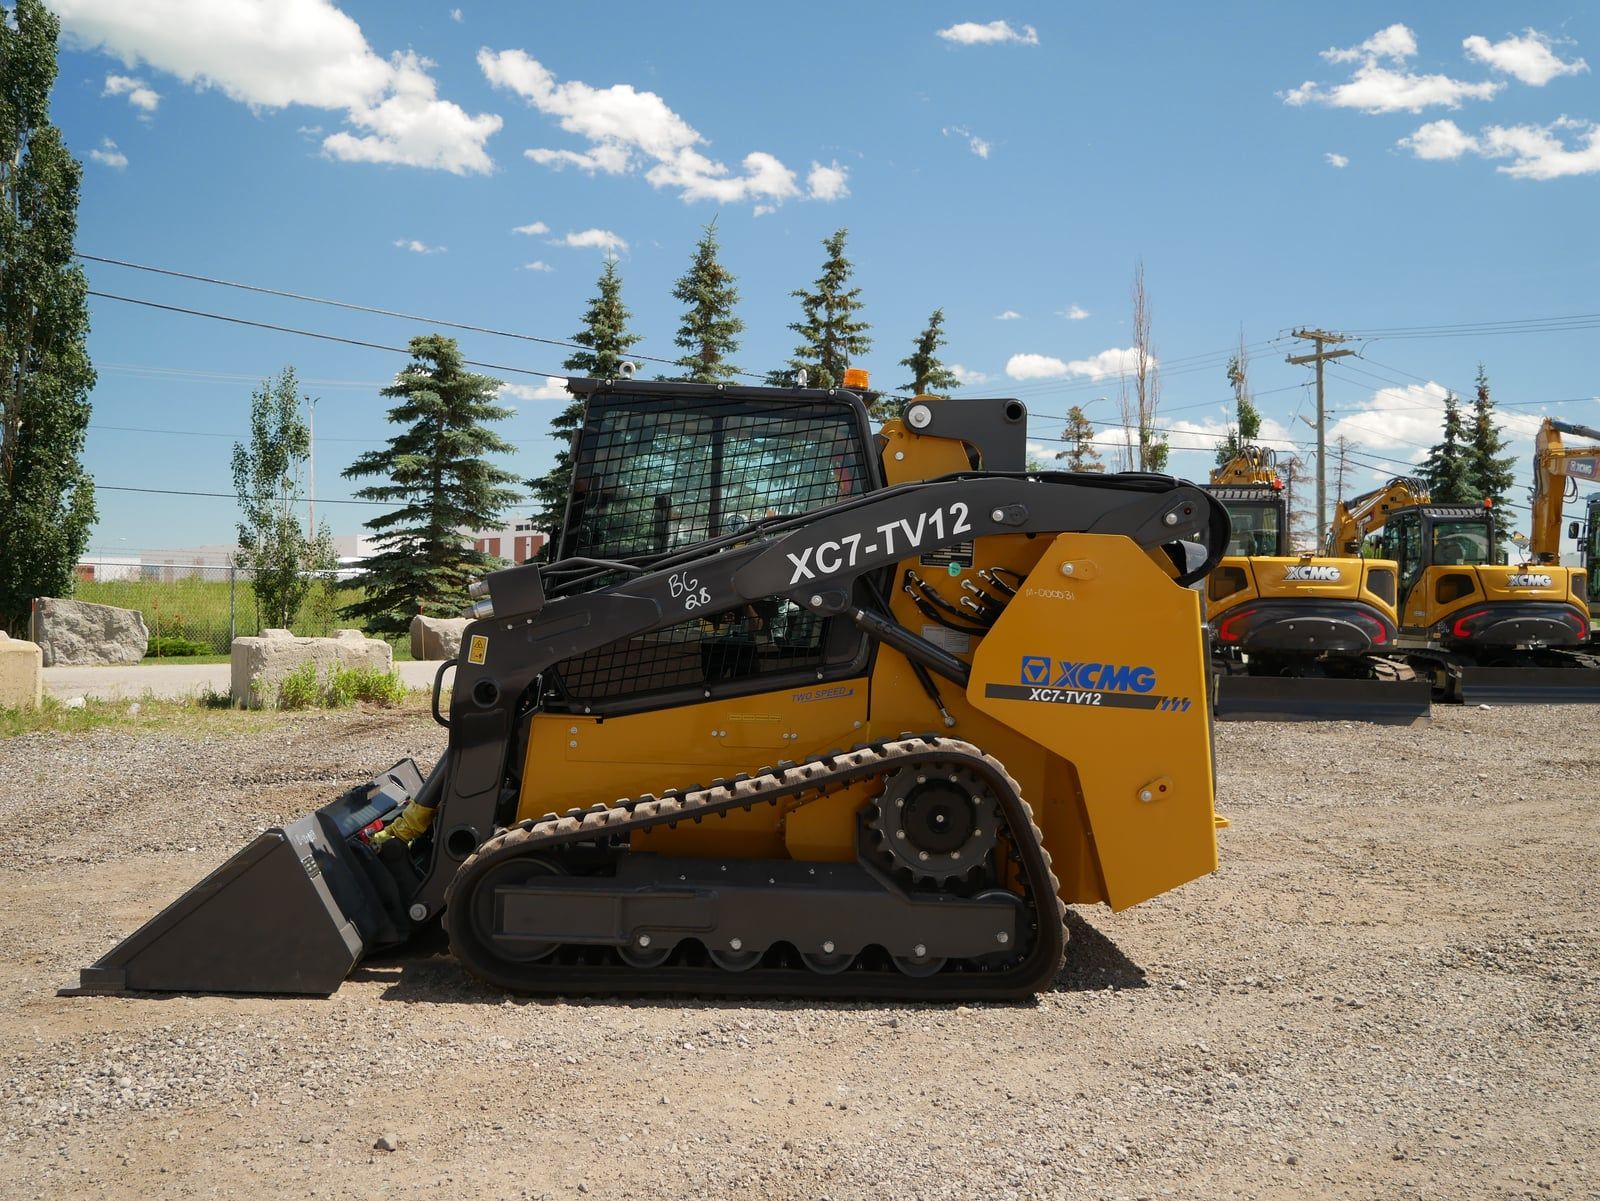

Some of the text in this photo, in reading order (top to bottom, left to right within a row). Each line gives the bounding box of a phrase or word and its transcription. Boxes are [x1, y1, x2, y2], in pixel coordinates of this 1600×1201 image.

[786, 502, 971, 585] XC7-TV12
[1284, 565, 1341, 581] XCMG
[1505, 574, 1552, 587] XCMG
[685, 587, 711, 610] 28
[1052, 661, 1156, 693] XCMG
[791, 687, 847, 702] TWO SPEED
[1029, 687, 1102, 706] XC7-TV12
